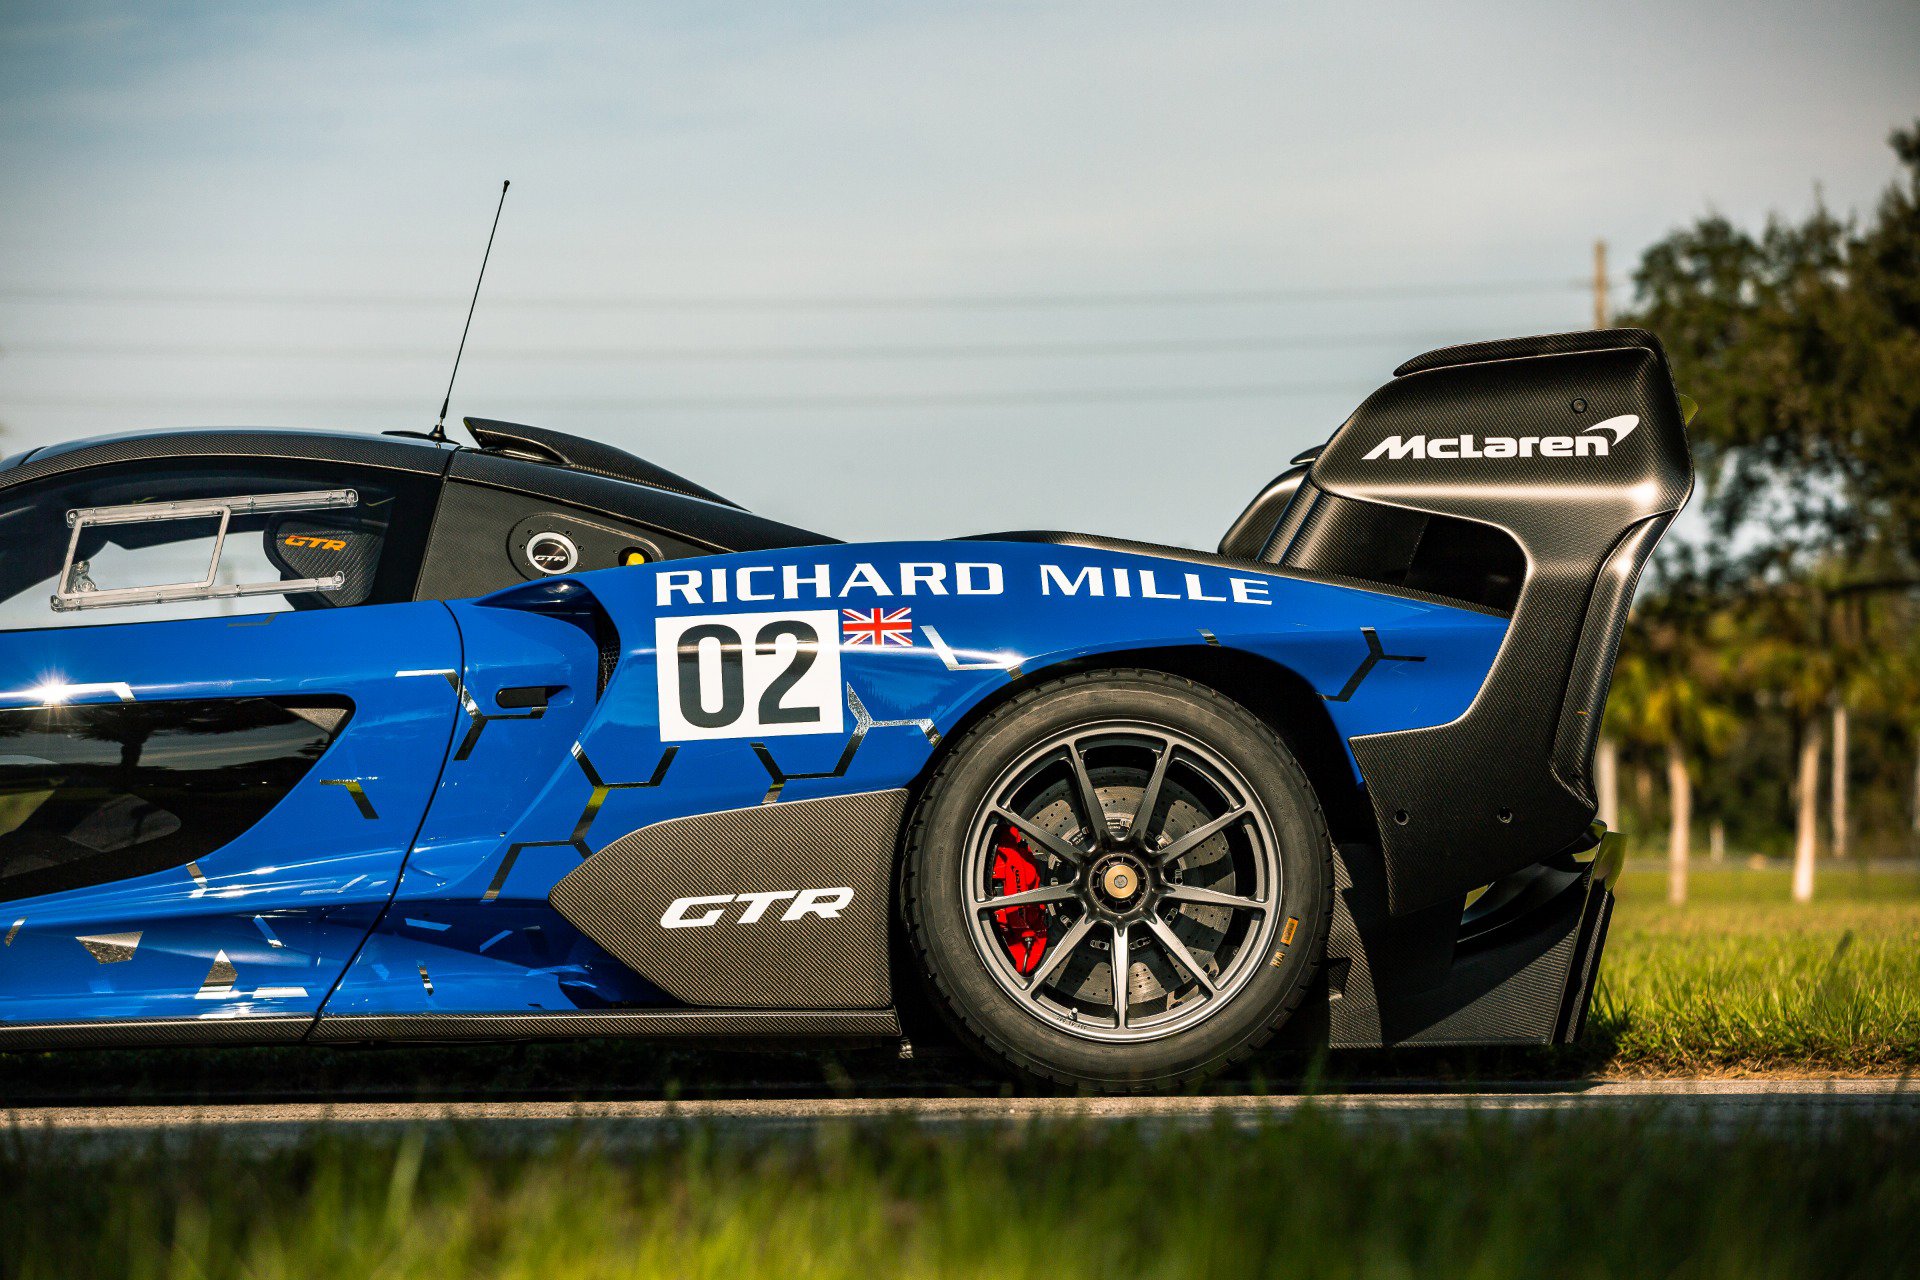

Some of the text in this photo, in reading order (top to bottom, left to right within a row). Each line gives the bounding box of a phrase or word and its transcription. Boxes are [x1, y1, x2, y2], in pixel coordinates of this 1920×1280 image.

[1361, 434, 1609, 460] McLaren
[284, 535, 347, 551] GTR
[534, 554, 566, 562] GTR
[655, 562, 1273, 607] RICHARD MILLE
[677, 620, 821, 729] 02
[660, 886, 855, 929] GTR
